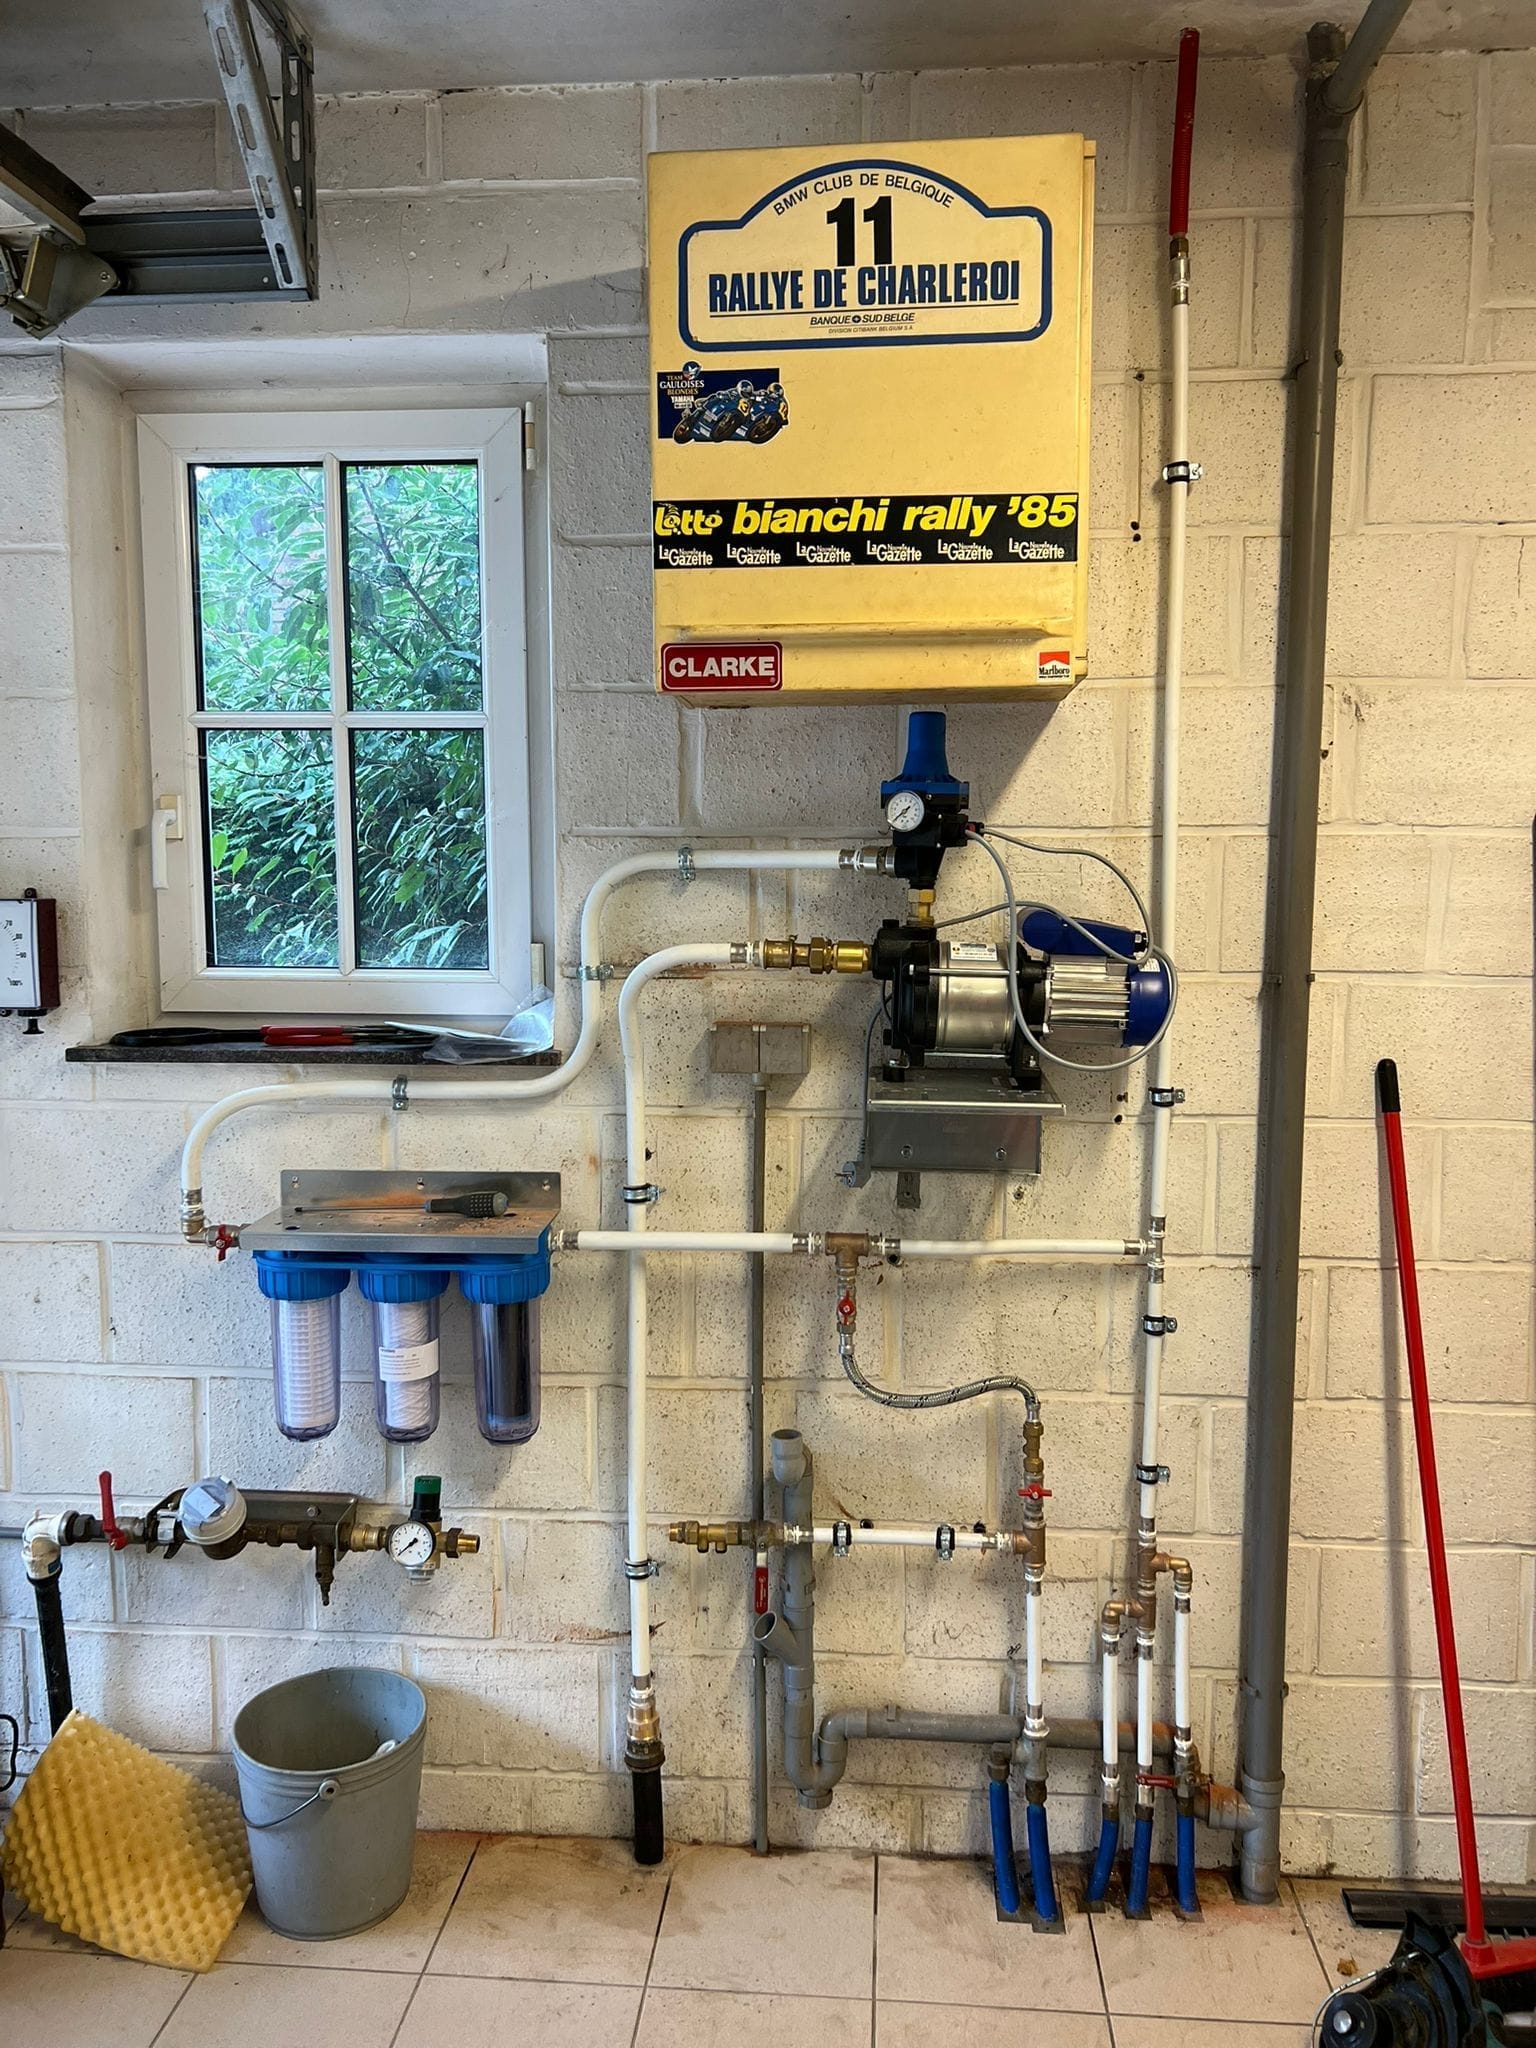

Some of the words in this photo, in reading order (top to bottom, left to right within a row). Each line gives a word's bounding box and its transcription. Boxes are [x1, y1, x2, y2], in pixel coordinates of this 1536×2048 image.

[773, 187, 808, 216] BMW
[814, 174, 853, 195] CLUB
[860, 173, 879, 186] DE
[885, 174, 955, 208] BELGIQUE
[826, 196, 892, 267] 11
[708, 270, 804, 313] RALLYE
[813, 268, 847, 308] DE
[857, 260, 1020, 306] CHARLEROI
[810, 315, 851, 325] BANQUE
[862, 314, 884, 323] SUD
[884, 312, 915, 322] BELGE
[659, 380, 705, 389] GAULOISES
[667, 388, 699, 396] BLONDES
[732, 499, 891, 534] bianchi
[902, 496, 997, 538] rally
[1006, 494, 1078, 528] '85
[659, 545, 669, 560] La
[668, 548, 713, 566] Gazette
[727, 543, 737, 558] La
[736, 547, 782, 565] Gazette
[796, 541, 806, 557] La
[806, 545, 851, 563] Gazette
[866, 540, 877, 555] La
[876, 544, 922, 562] Gazette
[938, 538, 948, 554] La
[947, 542, 993, 560] Gazette
[1009, 537, 1019, 553] La
[1018, 541, 1065, 559] Gazette
[668, 656, 776, 678] CLARKE
[1039, 664, 1070, 675] Marlboro
